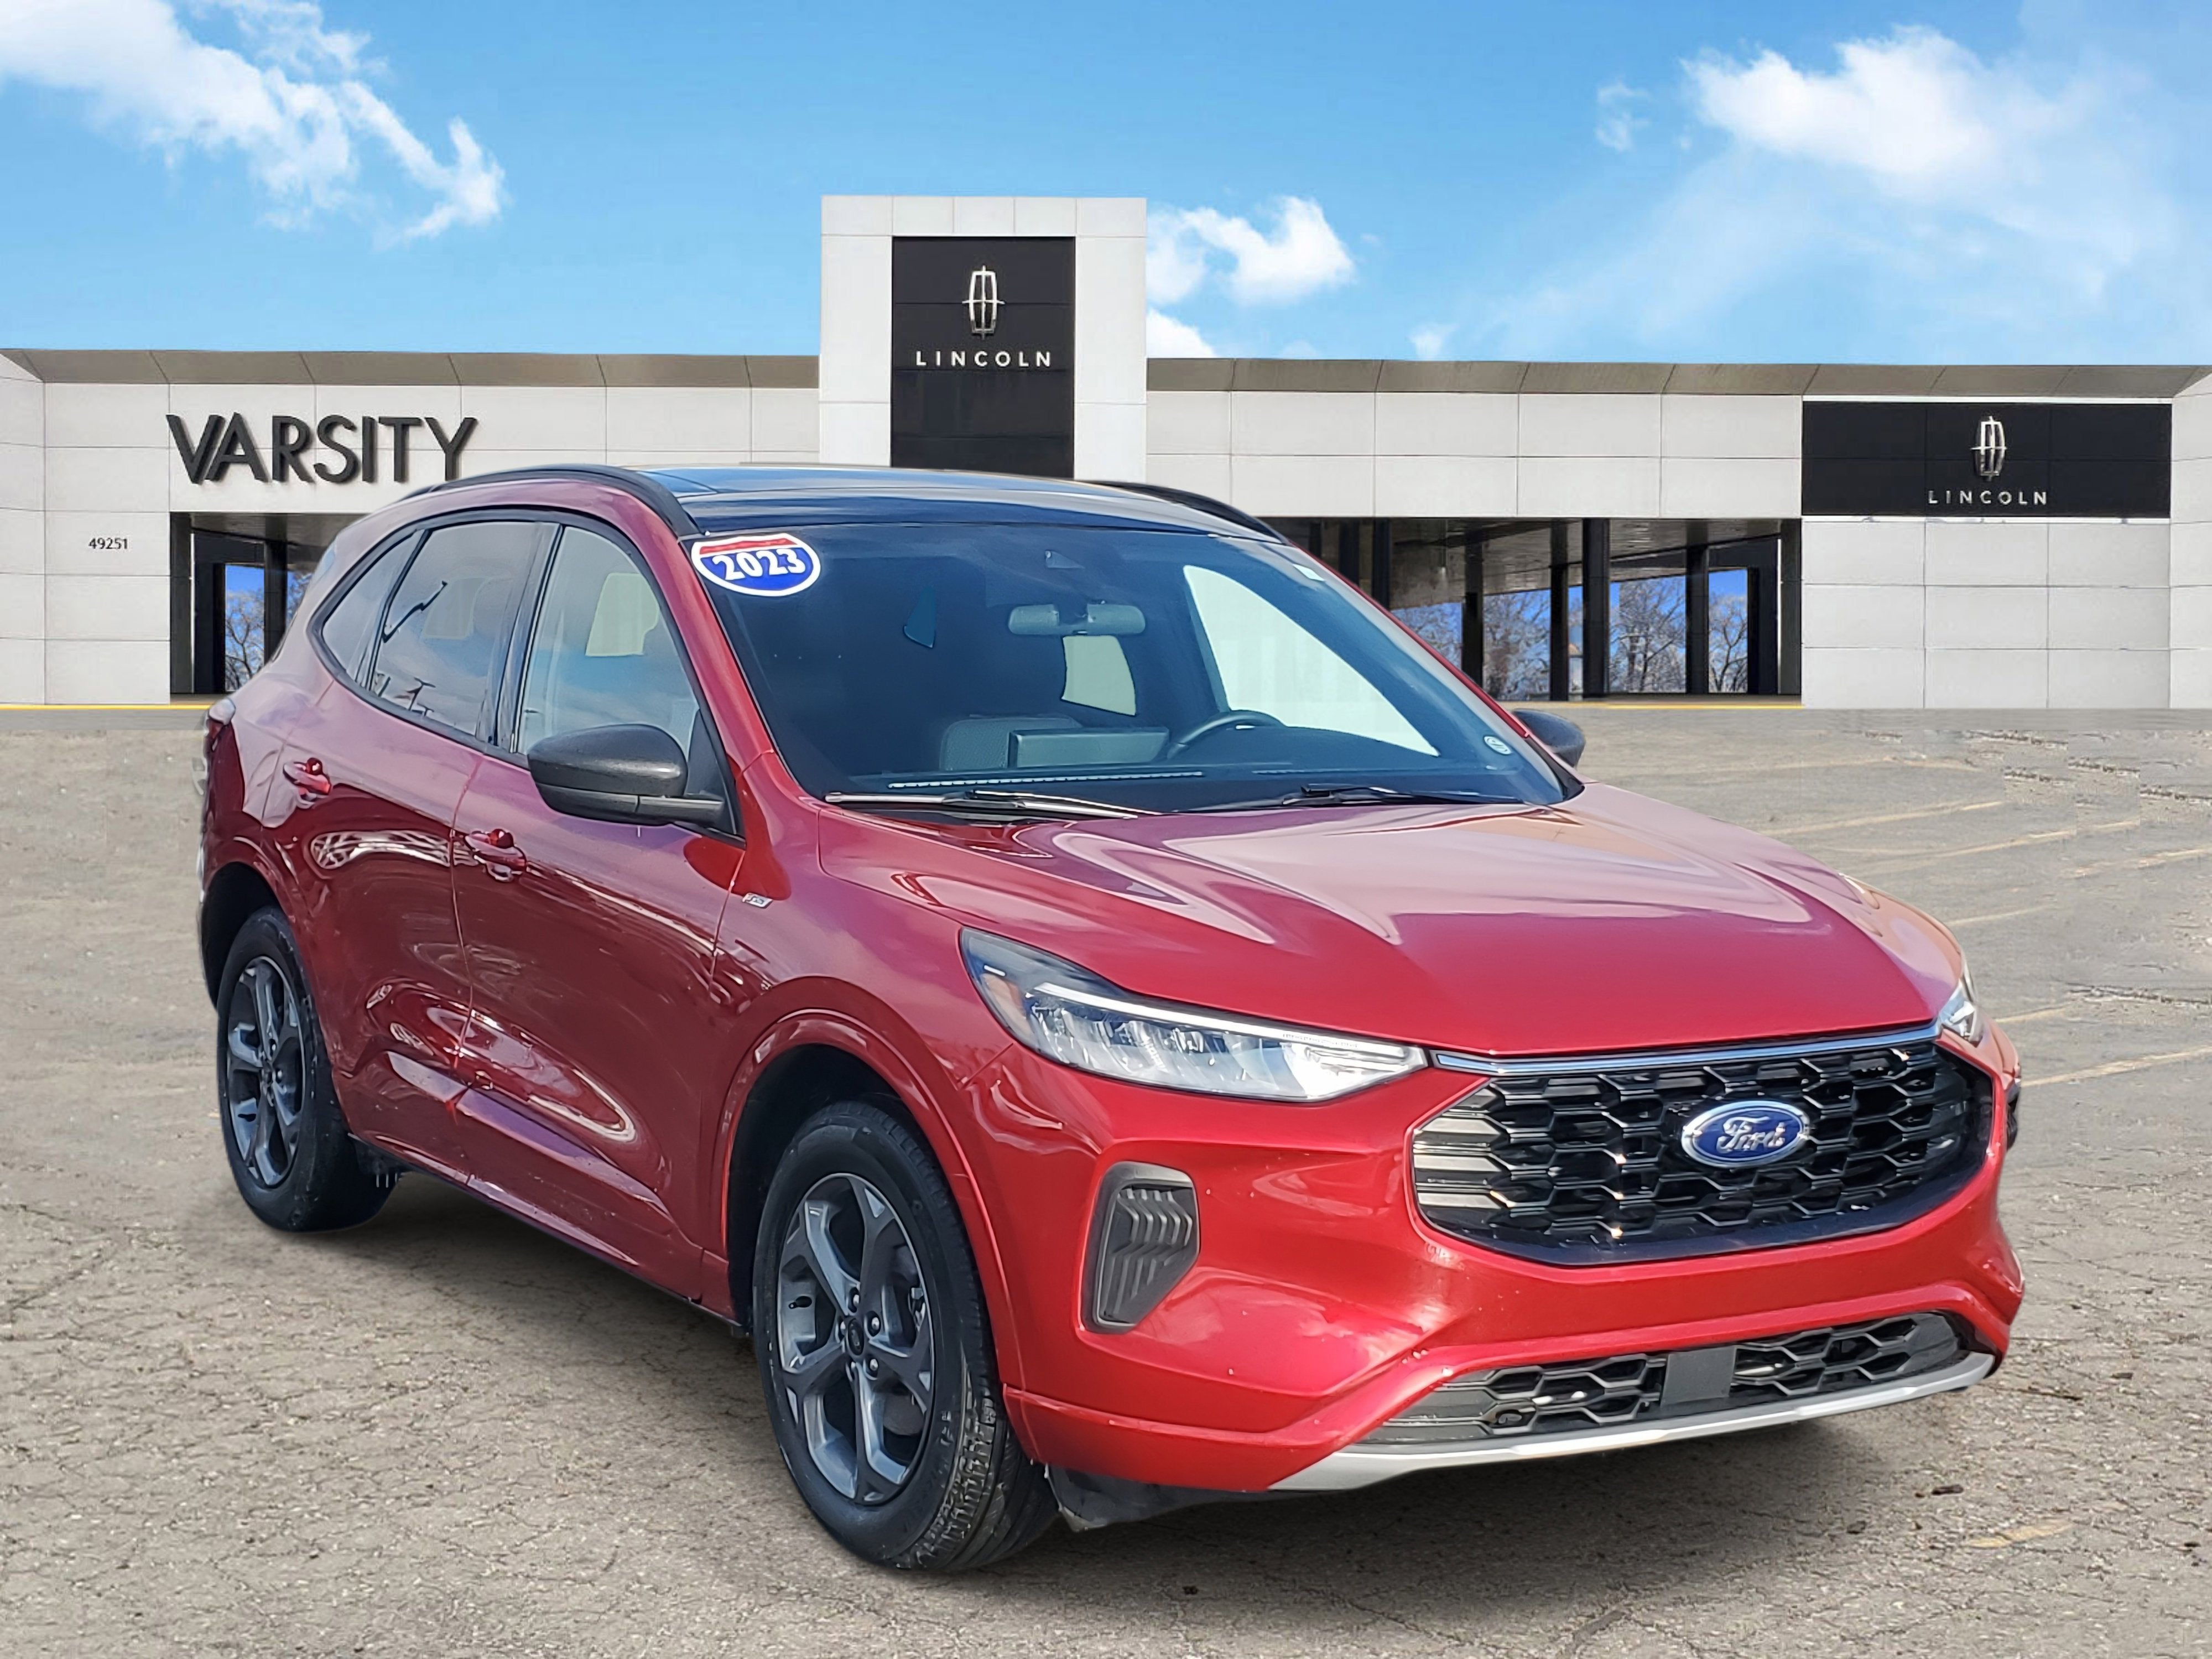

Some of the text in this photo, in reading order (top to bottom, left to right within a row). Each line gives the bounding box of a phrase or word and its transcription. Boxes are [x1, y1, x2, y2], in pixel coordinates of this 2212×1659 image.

[915, 350, 1051, 368] LINCOLN
[166, 412, 478, 485] VARSITY
[1928, 490, 2048, 505] LINCOLN
[89, 538, 128, 549] 49251
[712, 548, 806, 580] 2023
[1717, 1116, 1786, 1153] Ford
